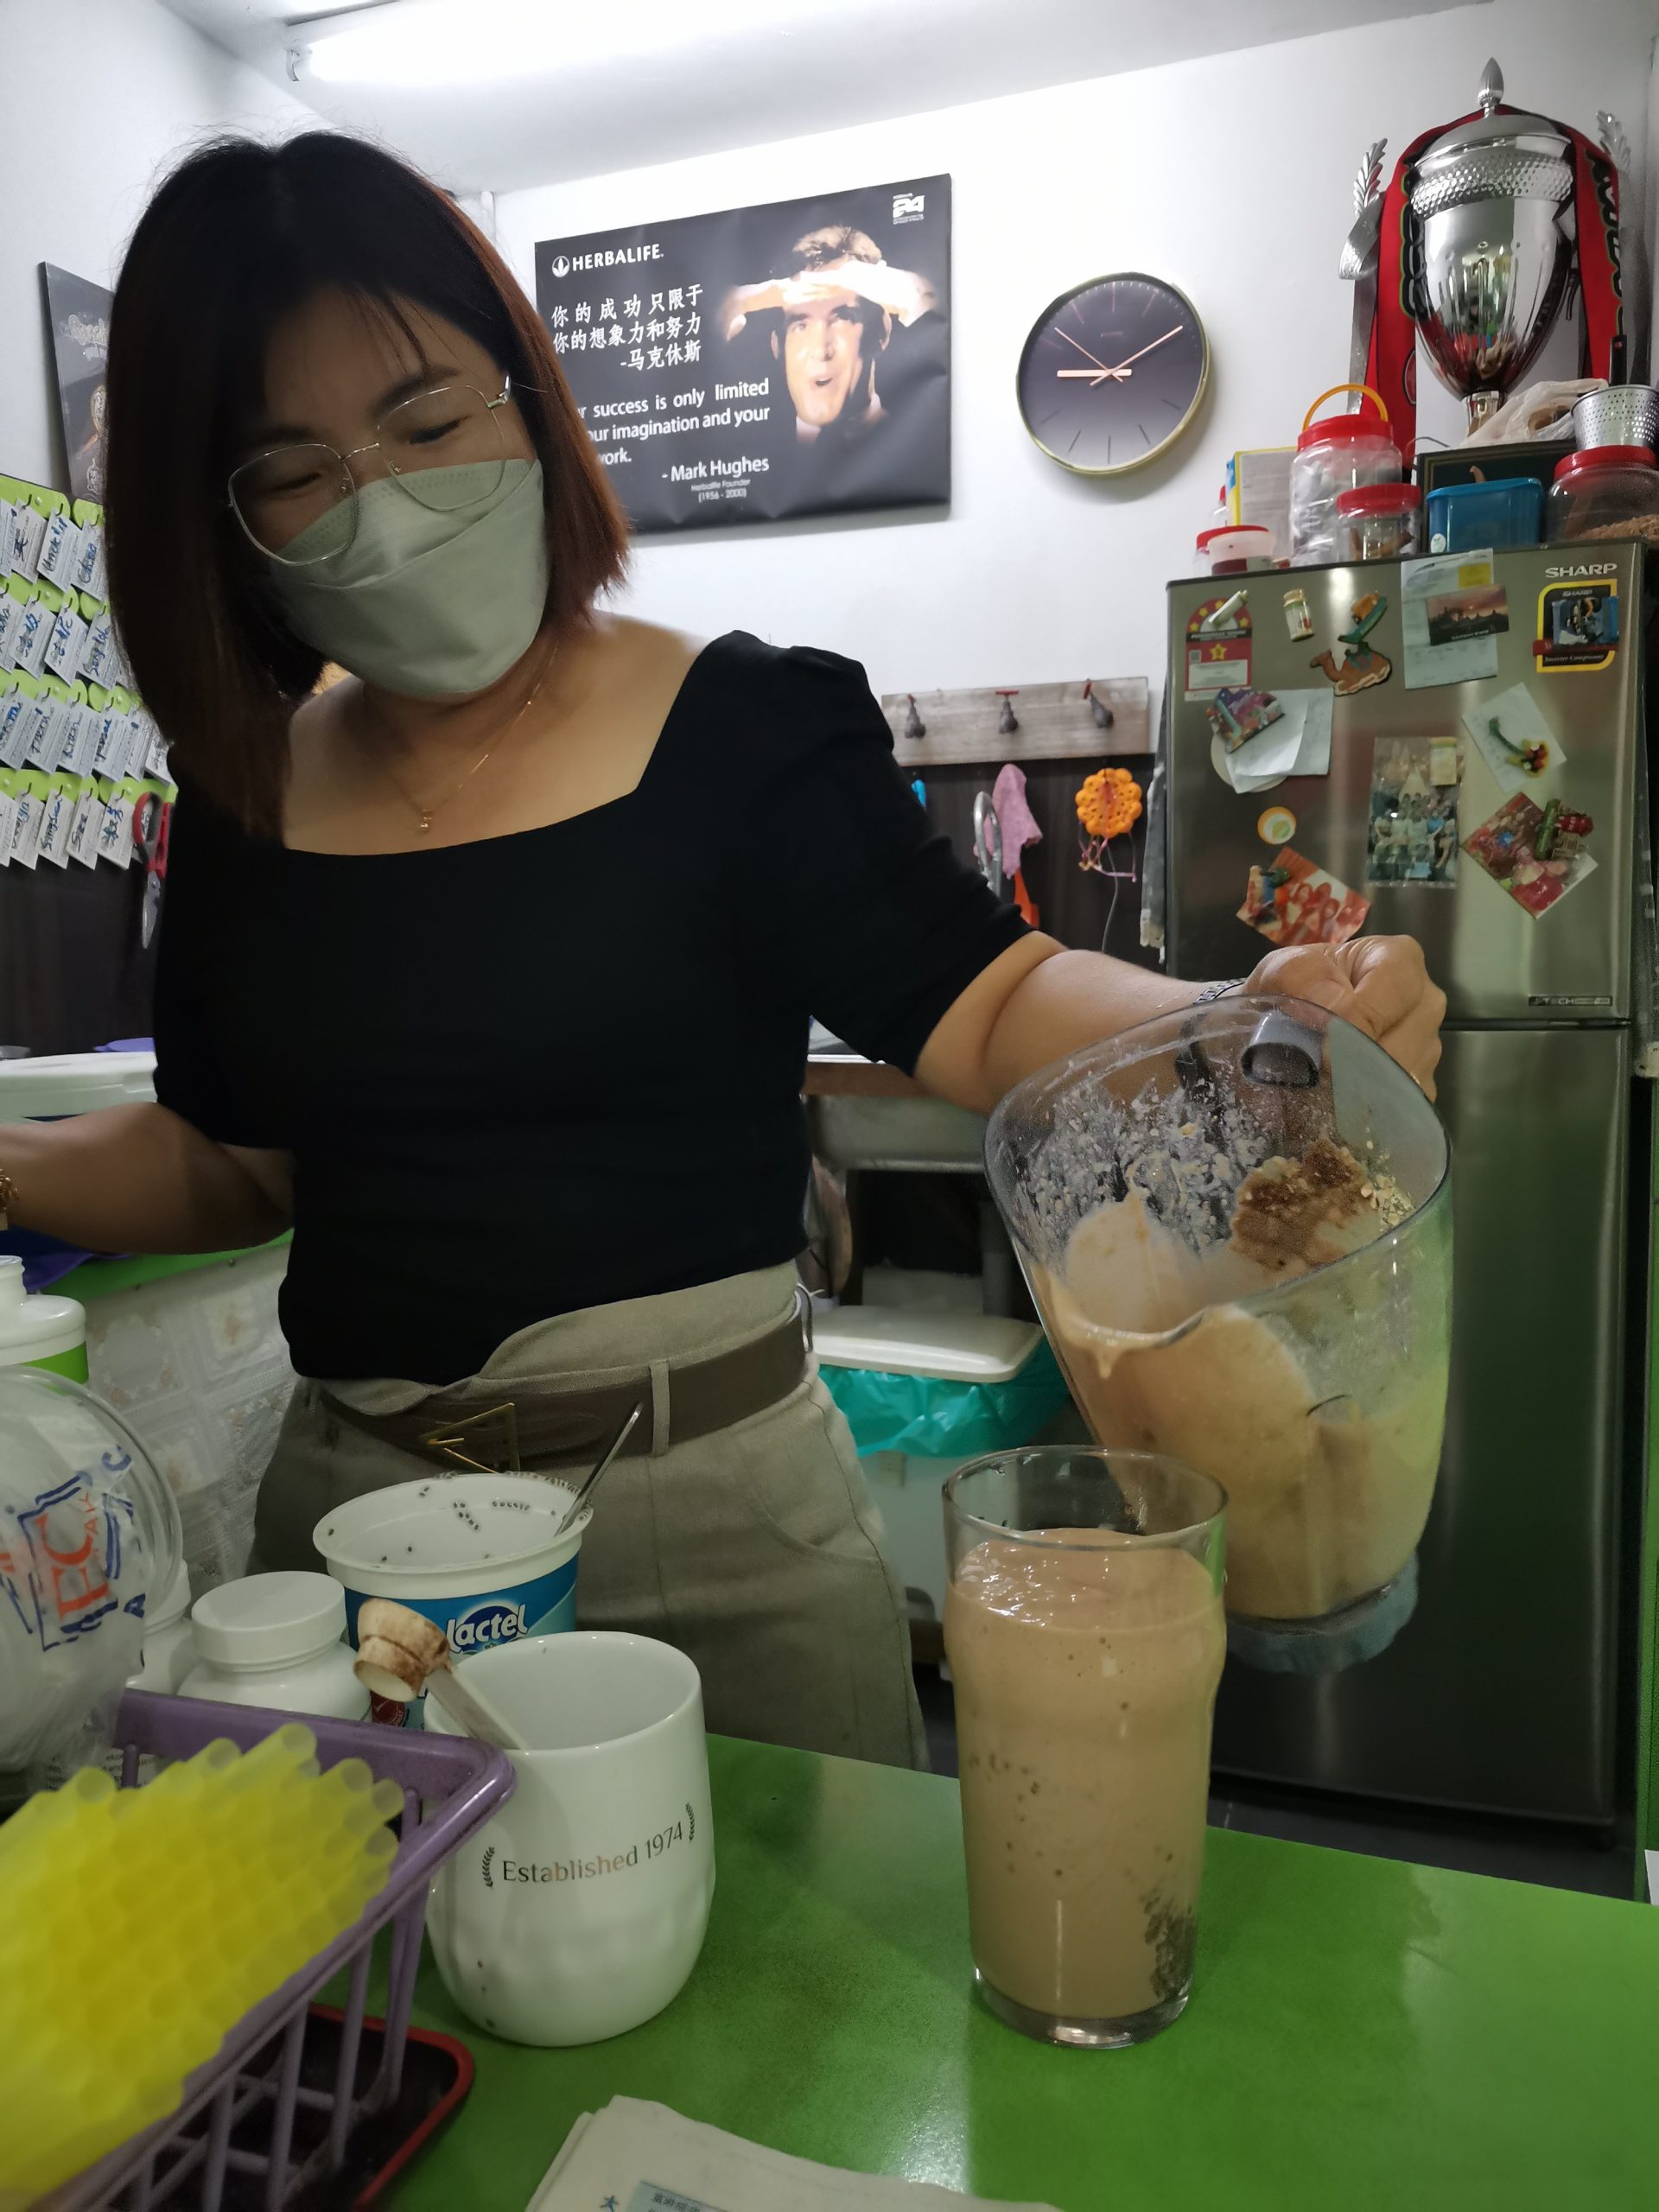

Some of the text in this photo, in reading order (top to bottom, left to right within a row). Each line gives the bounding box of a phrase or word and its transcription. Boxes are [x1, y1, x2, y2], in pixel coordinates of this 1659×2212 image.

[893, 194, 925, 219] 24
[572, 243, 661, 270] HERBALIFE
[553, 311, 702, 355] 你的想象力和努力
[594, 397, 649, 417] success
[655, 394, 667, 410] is
[673, 388, 705, 409] only
[715, 377, 769, 401] limited
[612, 416, 699, 441] imagination
[702, 407, 731, 428] and
[734, 407, 770, 428] your
[671, 461, 707, 482] Mark
[710, 456, 770, 478] Hughes
[1544, 563, 1618, 578] SHARP
[447, 1604, 529, 1653] lactel
[502, 1821, 683, 1884] Established 1974
